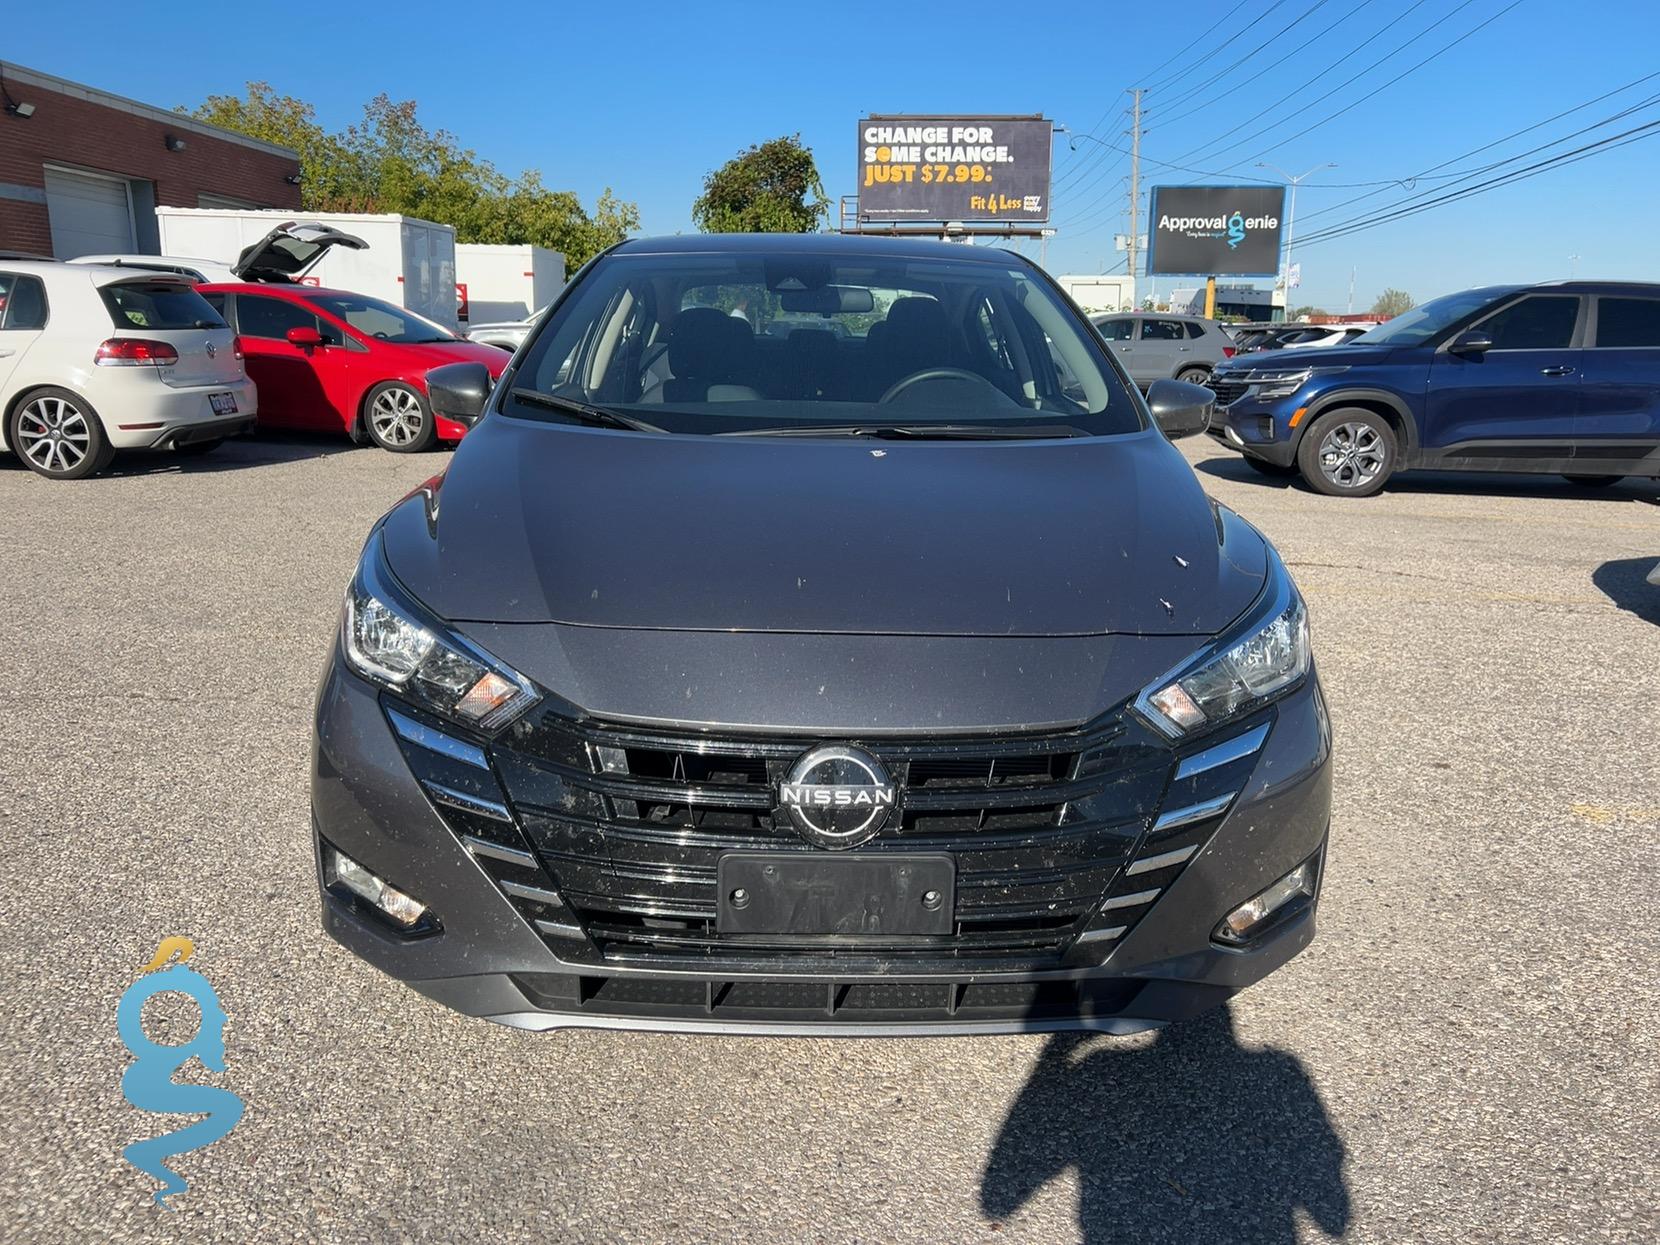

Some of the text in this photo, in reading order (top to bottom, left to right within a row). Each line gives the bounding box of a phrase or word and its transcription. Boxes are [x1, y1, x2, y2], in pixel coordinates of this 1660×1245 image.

[864, 127, 994, 144] CHANGE FOR
[864, 146, 1014, 163] SOME CHANGE.
[864, 164, 917, 187] JUST
[970, 195, 986, 210] Fit
[988, 194, 998, 214] 4
[999, 194, 1022, 210] Less
[1158, 214, 1227, 232] Approval
[782, 787, 893, 805] NISSAN
